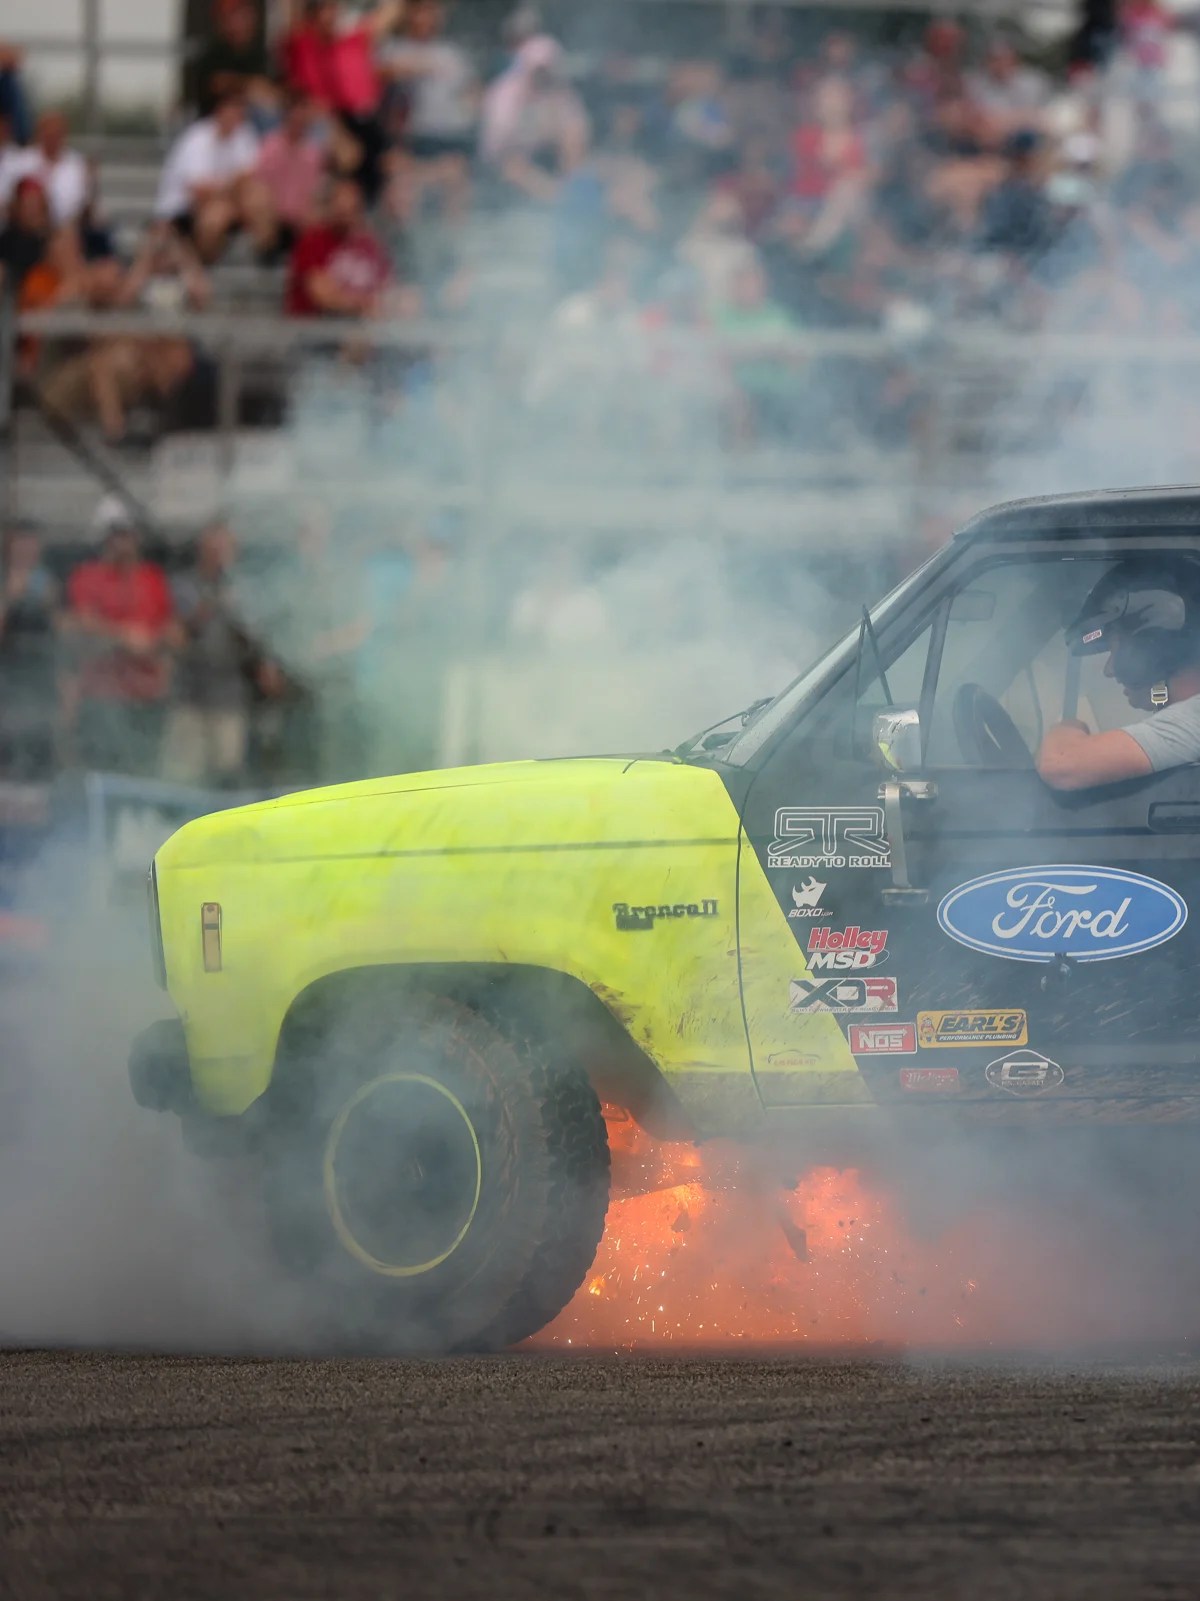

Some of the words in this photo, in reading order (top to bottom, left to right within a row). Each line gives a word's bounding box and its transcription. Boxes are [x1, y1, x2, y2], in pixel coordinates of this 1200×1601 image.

[767, 856, 820, 868] READY
[820, 856, 846, 868] TO
[848, 856, 892, 868] ROLL
[788, 908, 822, 918] BOXO
[991, 881, 1133, 939] Ford
[808, 926, 888, 955] Holley
[805, 951, 877, 970] MSD
[940, 1015, 1021, 1033] EARL'S
[859, 1029, 904, 1048] NOS
[985, 1033, 1017, 1041] PLUMBING
